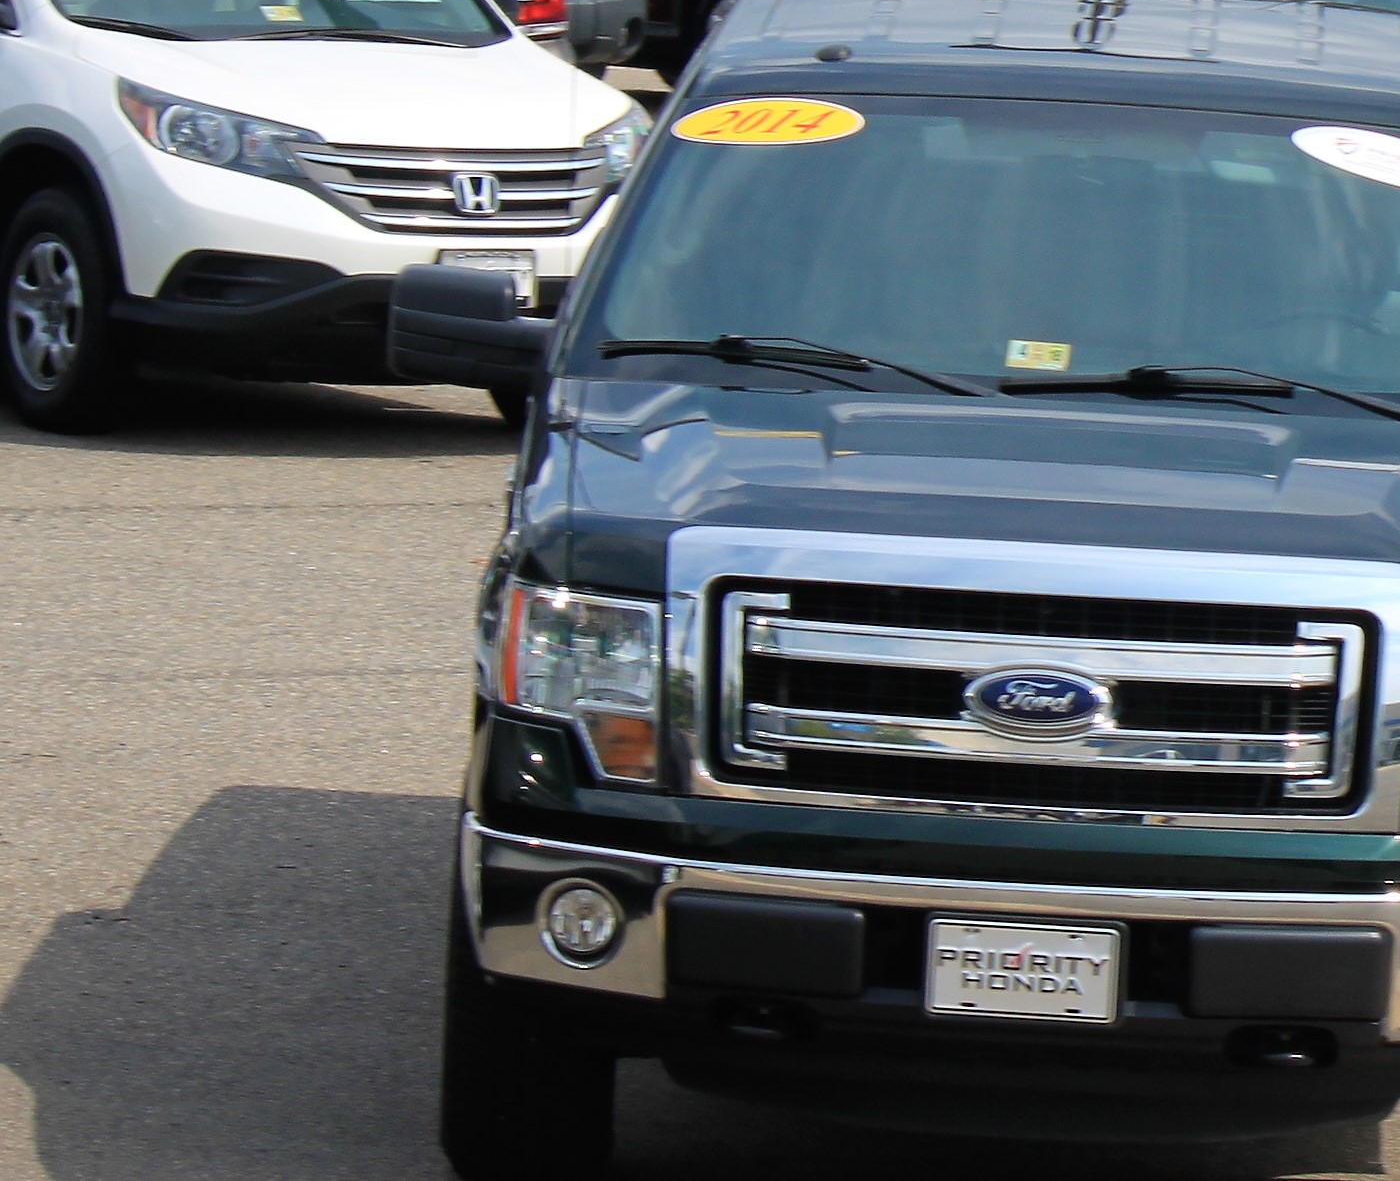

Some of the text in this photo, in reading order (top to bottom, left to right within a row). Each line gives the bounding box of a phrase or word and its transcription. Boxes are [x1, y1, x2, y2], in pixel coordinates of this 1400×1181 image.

[697, 108, 837, 136] 2014
[997, 679, 1076, 713] Ford
[935, 946, 1110, 976] PRIORITY
[961, 971, 1084, 996] HONDA
